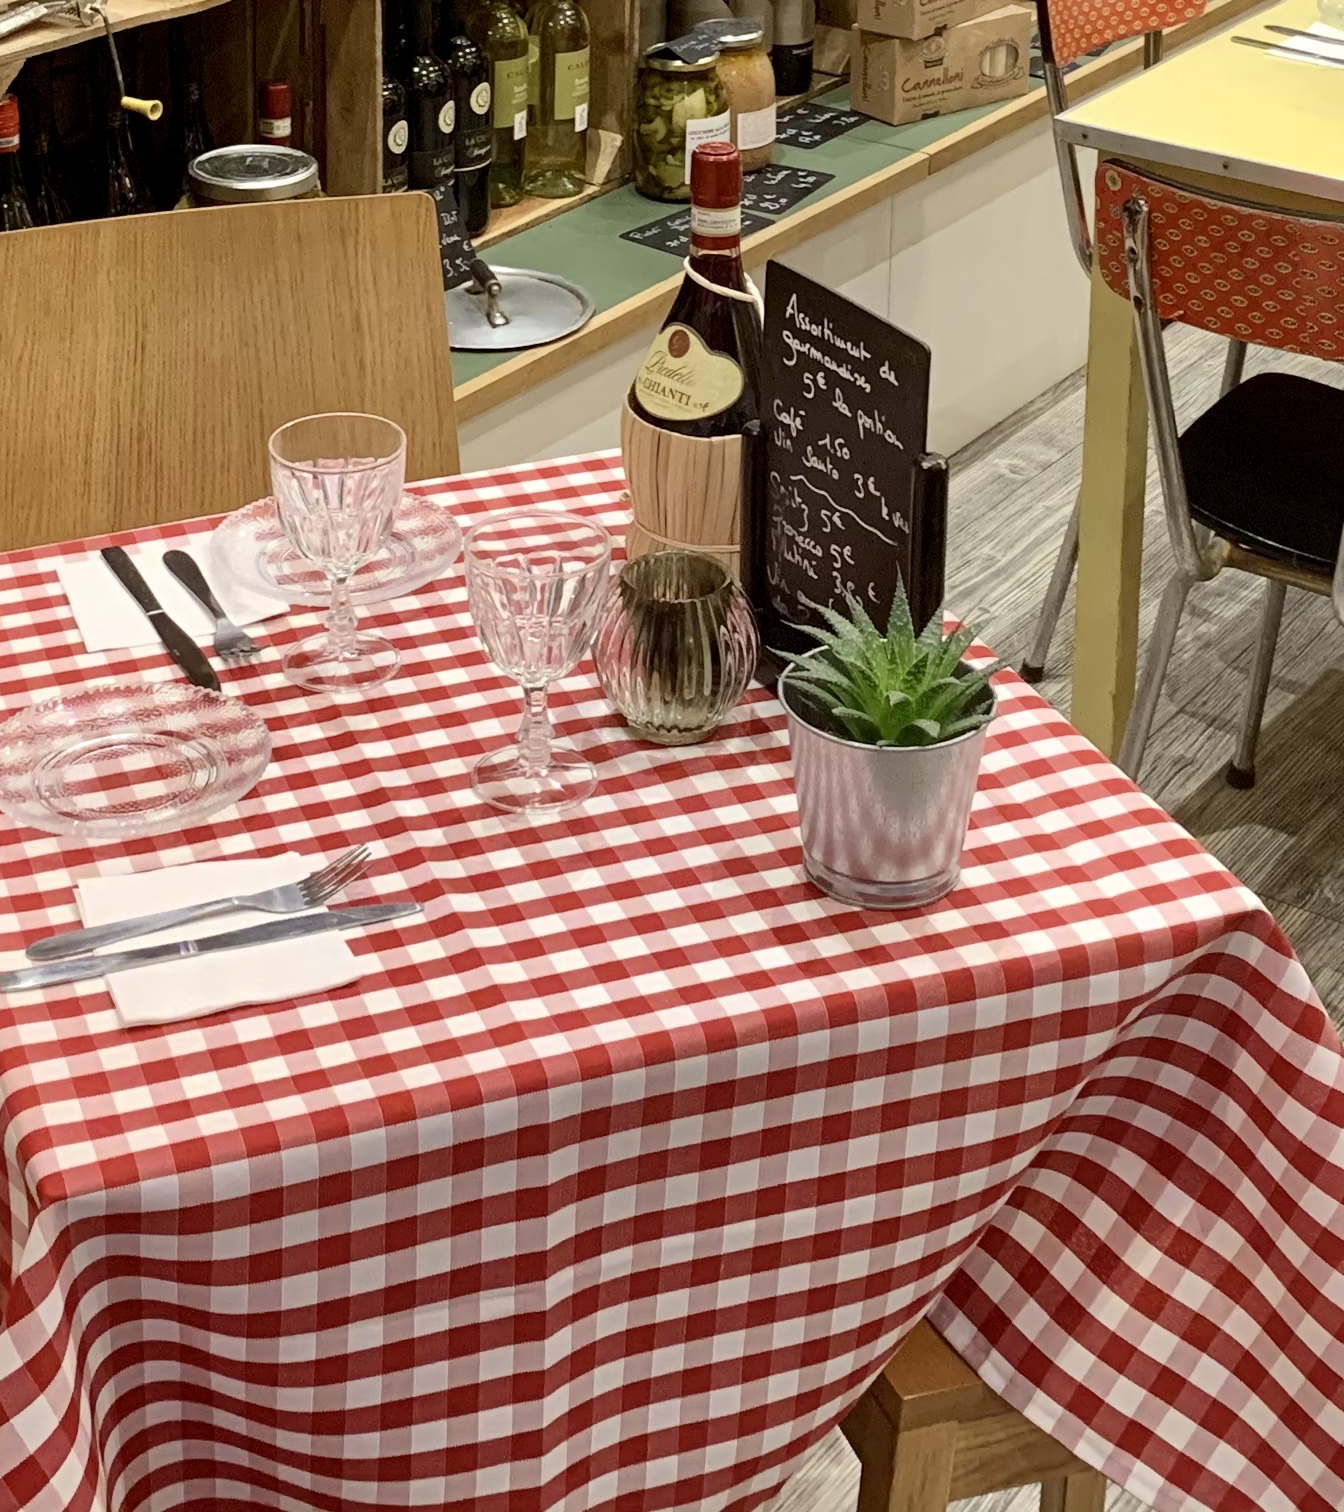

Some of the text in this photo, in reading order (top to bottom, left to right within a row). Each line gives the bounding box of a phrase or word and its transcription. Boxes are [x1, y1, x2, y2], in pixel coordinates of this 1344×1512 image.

[901, 68, 964, 94] Cannelloni
[785, 292, 872, 362] Assortiment
[642, 376, 692, 407] CHIANTI
[773, 398, 806, 438] Café
[856, 409, 904, 451] portion
[773, 426, 793, 453] Vin
